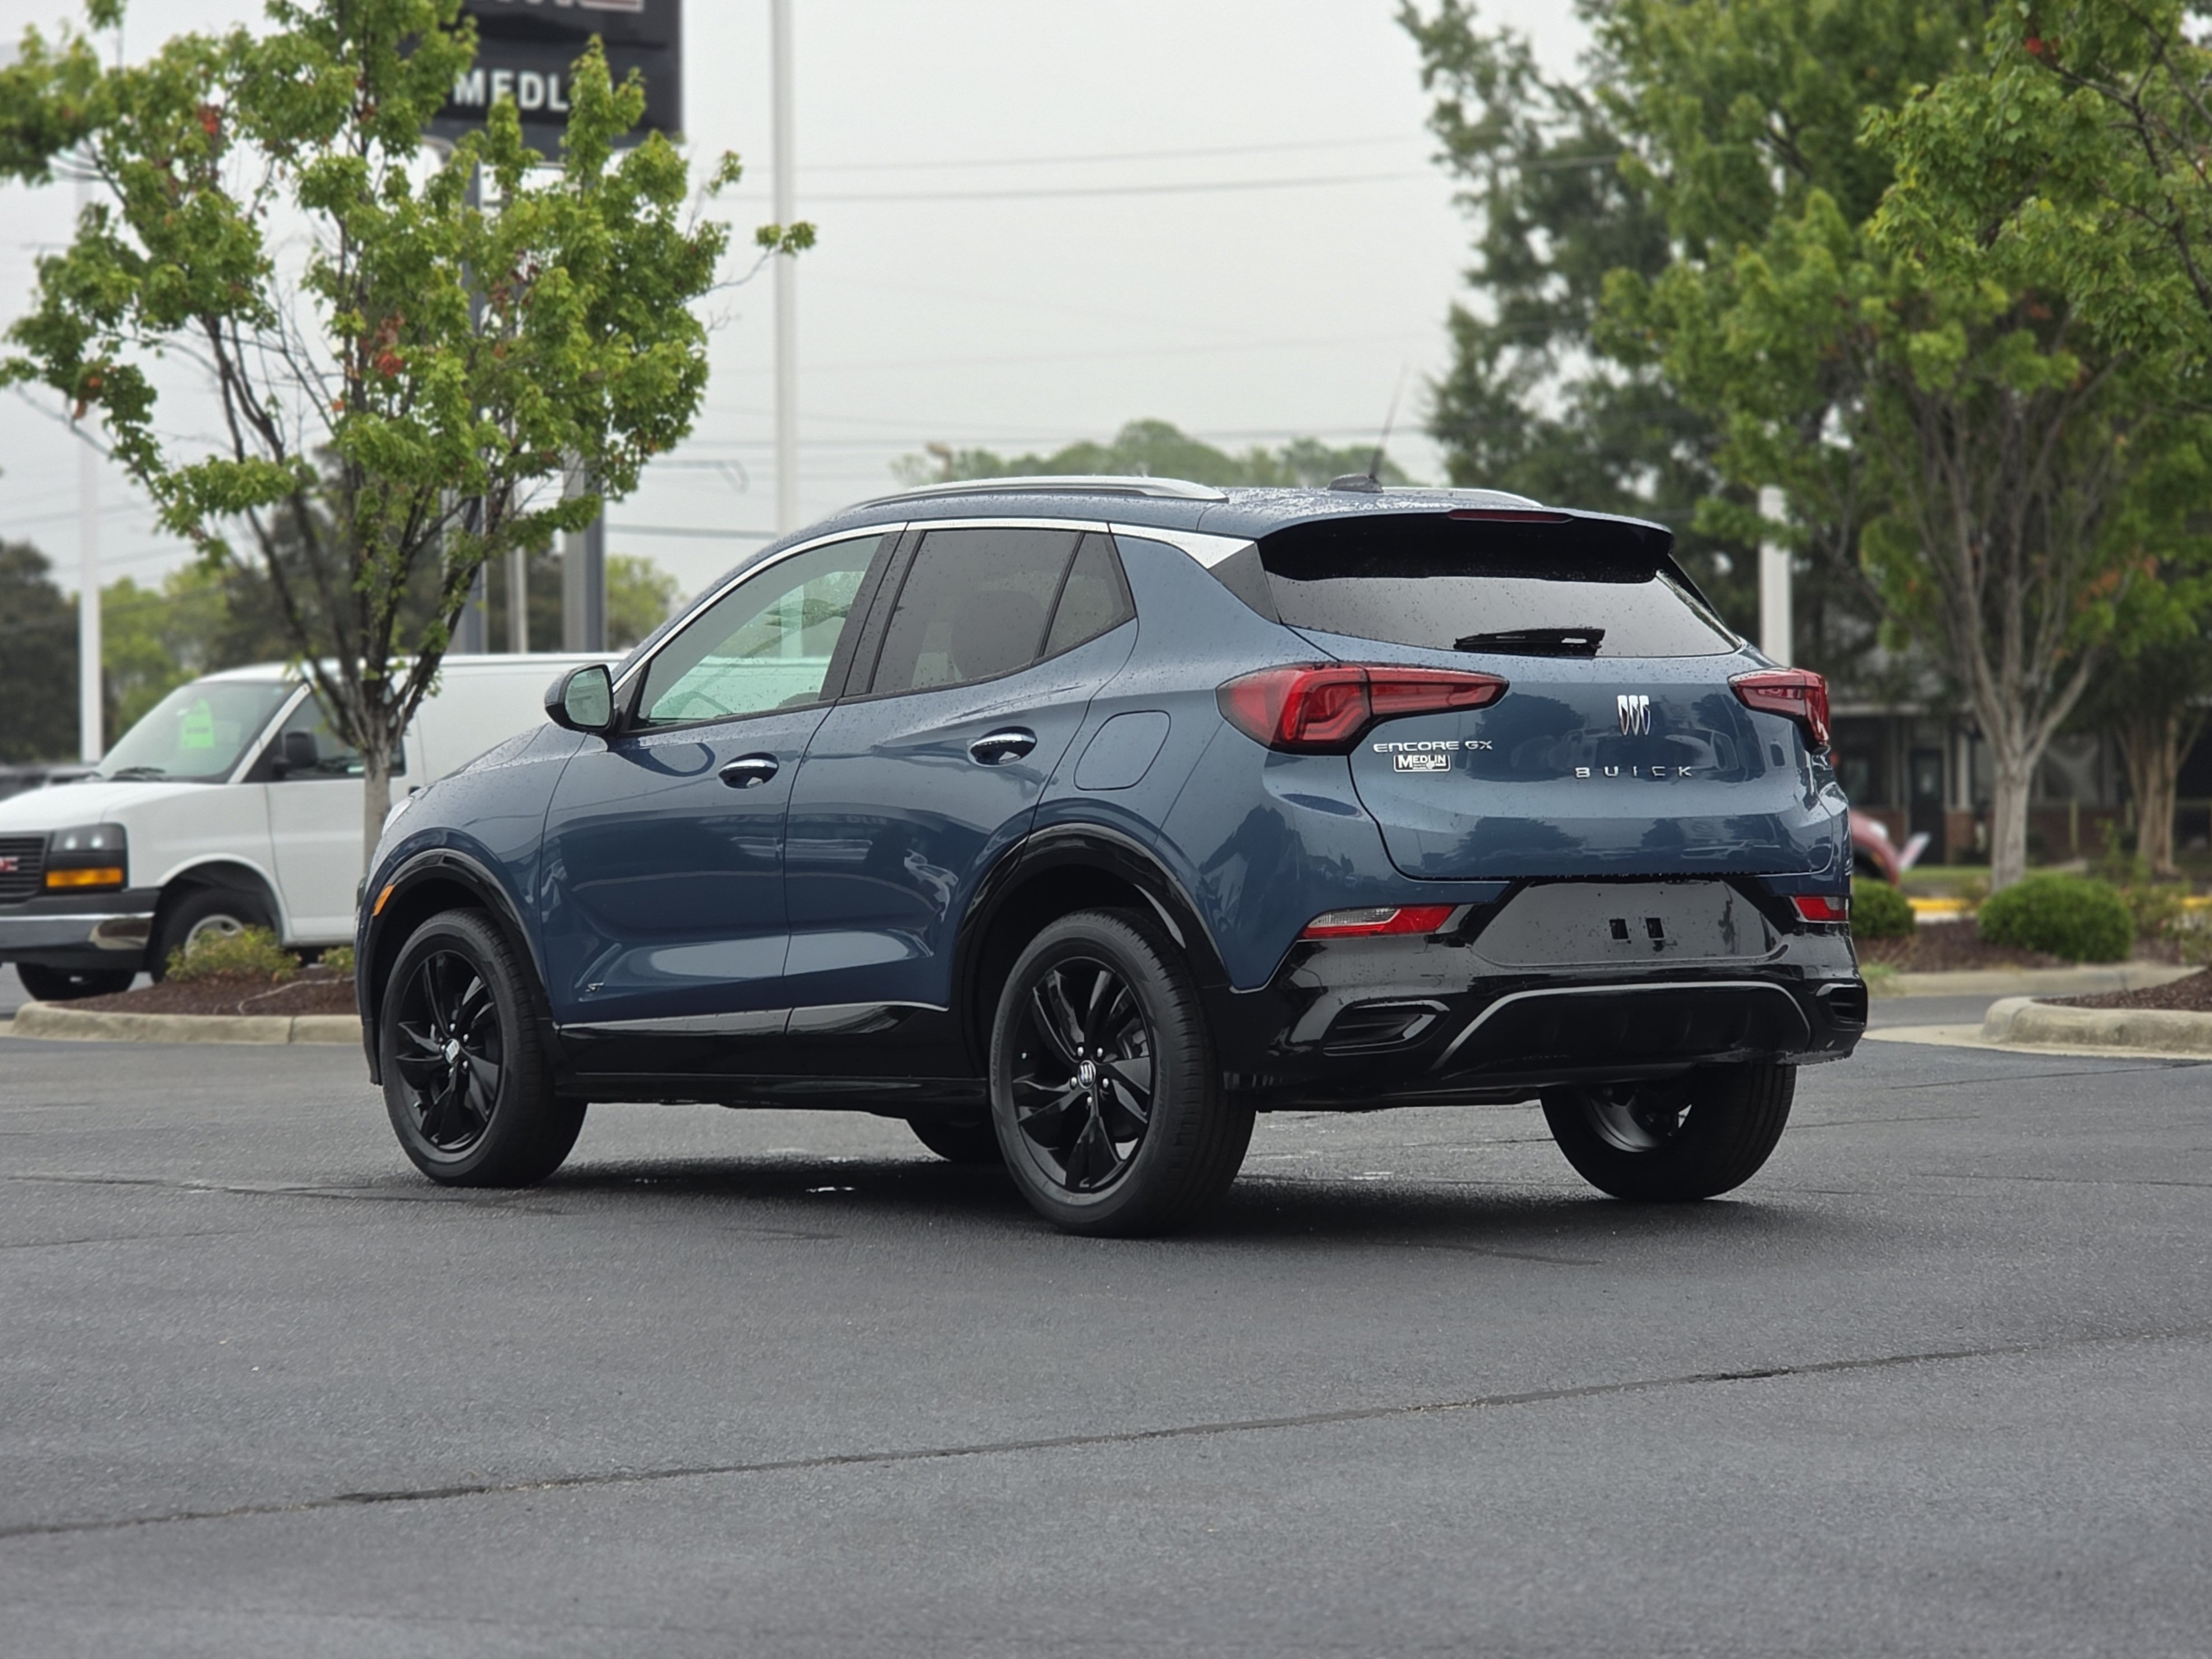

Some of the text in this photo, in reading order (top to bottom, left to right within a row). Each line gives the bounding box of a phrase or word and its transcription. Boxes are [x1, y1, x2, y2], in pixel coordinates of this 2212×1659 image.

[453, 67, 613, 112] MEDL
[1373, 741, 1493, 752] ENCORE GX
[1575, 765, 1692, 778] BUICK
